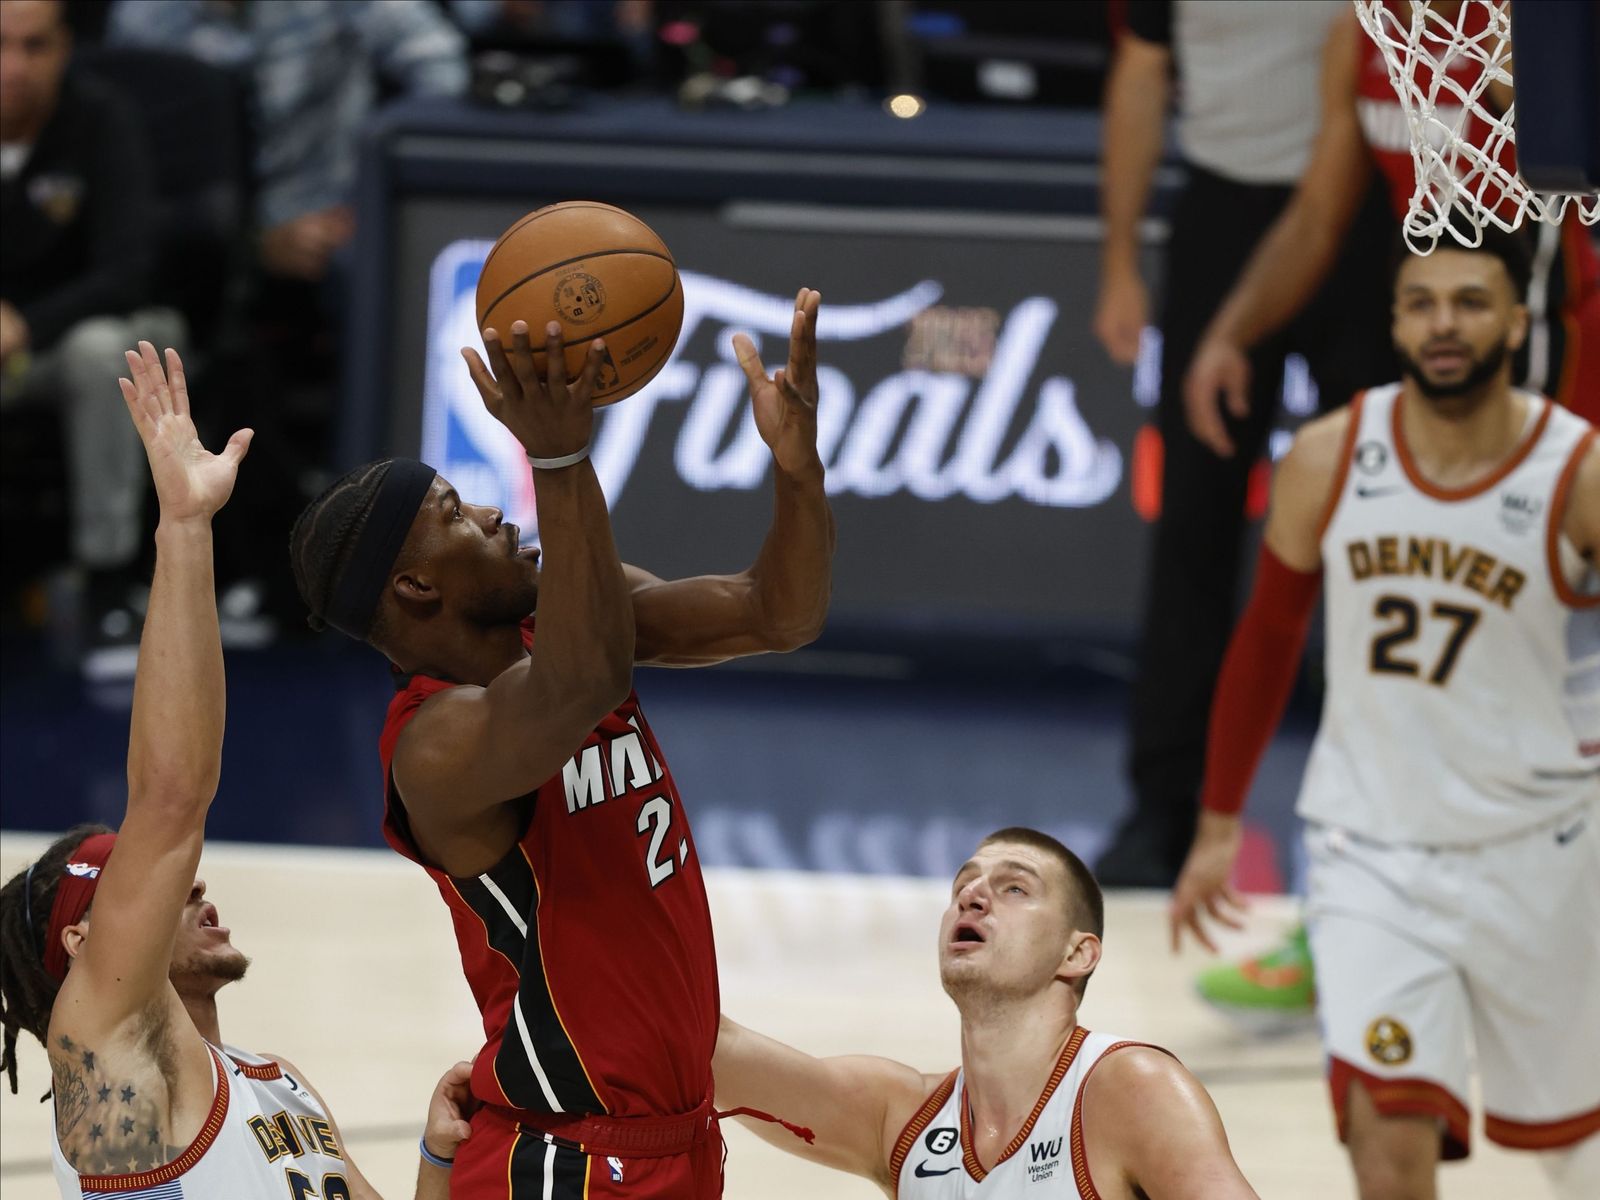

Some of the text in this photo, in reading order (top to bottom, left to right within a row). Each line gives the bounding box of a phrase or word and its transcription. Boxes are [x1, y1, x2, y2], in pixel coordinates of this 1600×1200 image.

[1347, 535, 1527, 610] DENVER
[1369, 593, 1482, 687] 27
[636, 796, 689, 889] 2
[931, 1131, 955, 1152] 6
[1031, 1136, 1063, 1162] WU
[1028, 1160, 1059, 1174] Western
[1032, 1170, 1053, 1182] Union
